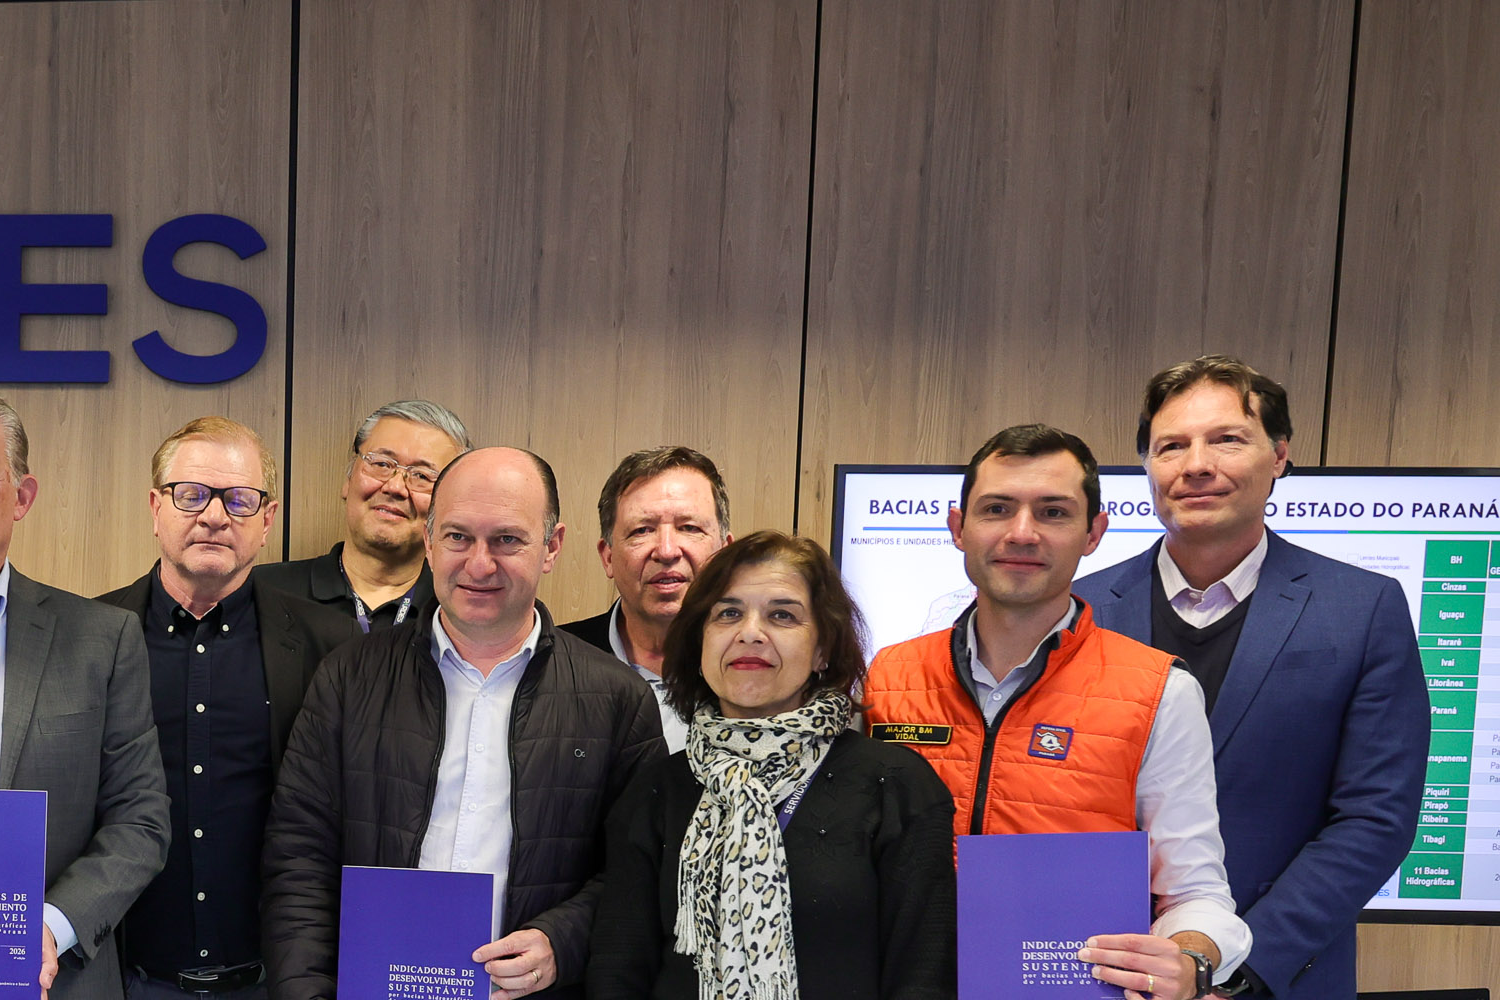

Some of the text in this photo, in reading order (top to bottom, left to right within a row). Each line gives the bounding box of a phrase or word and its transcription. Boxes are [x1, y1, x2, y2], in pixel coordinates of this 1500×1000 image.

[869, 499, 940, 515] BACIAS
[1286, 502, 1365, 518] ESTADO
[1373, 502, 1404, 518] DO
[1412, 499, 1500, 518] PARANÁ
[851, 537, 894, 545] MUNICÍPIOS
[1450, 555, 1463, 564] BH
[1441, 583, 1467, 591] Cinzas
[1439, 610, 1465, 620] Iguaçu
[1437, 638, 1462, 646] Itararé
[1441, 658, 1455, 667] Ivaí
[1429, 678, 1464, 687] Litorânea
[1431, 706, 1457, 714] Paraná
[1426, 788, 1450, 797] Piquiri
[1424, 801, 1448, 811] Pirapó
[1422, 815, 1448, 823] Ribeira
[1422, 835, 1446, 845] Tibagi
[1414, 867, 1449, 875] 11 Bacias
[1406, 877, 1455, 887] Hidrográficas
[13, 893, 27, 901] DE
[1022, 941, 1087, 950] INDICADO
[9, 947, 26, 955] 2026
[389, 964, 474, 977] INDICADORES DE
[1022, 963, 1089, 971] SUSTENT
[389, 974, 474, 987] DESENVOLVIMENTO
[388, 983, 473, 996] SUSTENTÁVEL
